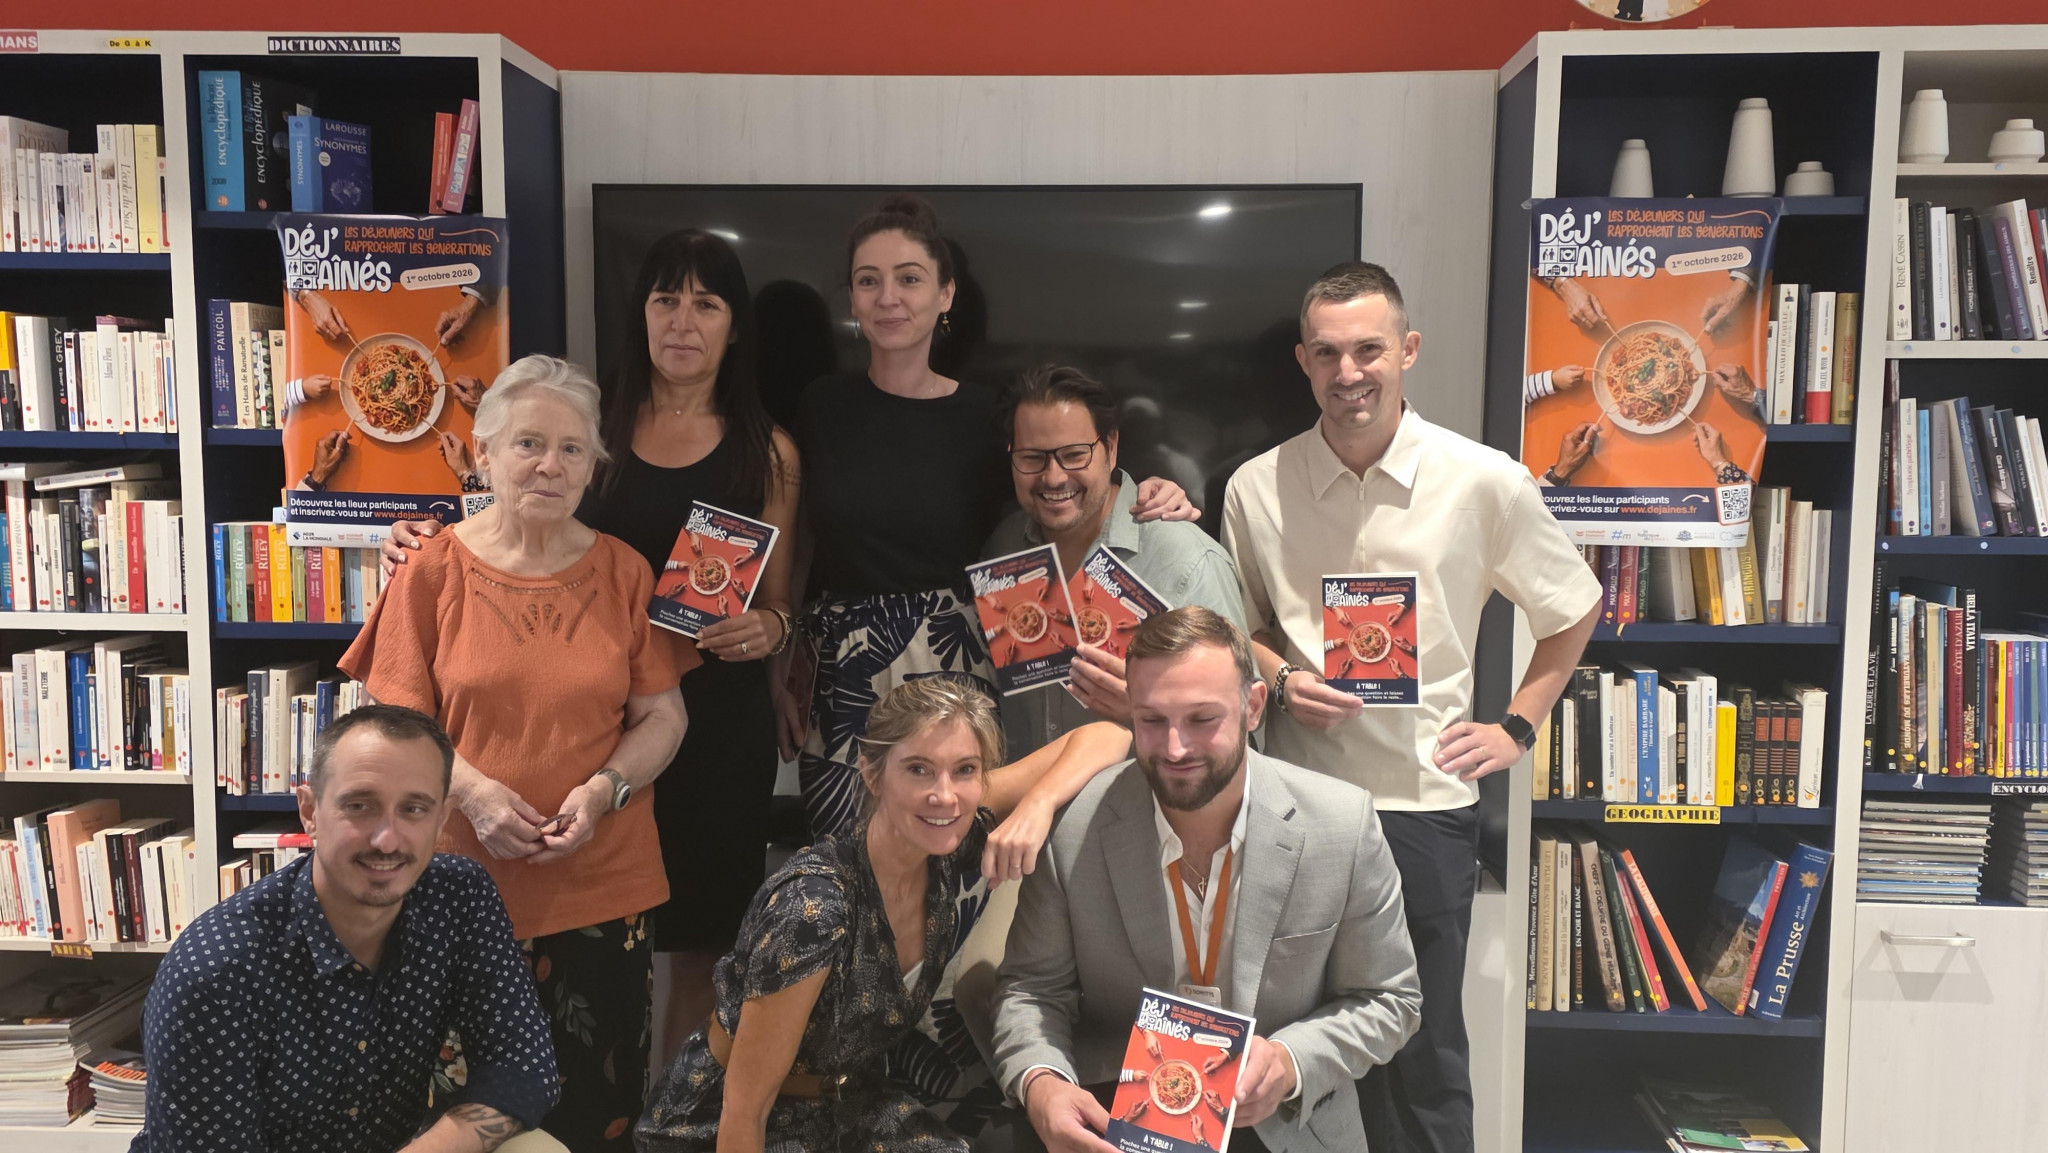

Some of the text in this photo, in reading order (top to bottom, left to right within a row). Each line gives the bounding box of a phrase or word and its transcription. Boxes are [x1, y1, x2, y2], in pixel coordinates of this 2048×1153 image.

[269, 38, 401, 52] DICTIONNAIRES
[325, 123, 368, 136] LAROUSSE
[314, 137, 367, 154] SYNONYMES
[1607, 224, 1674, 238] RAPPROCHENT
[344, 240, 405, 254] RAPPROCHENT
[1684, 256, 1720, 268] octobre
[1721, 252, 1744, 263] 2026
[1896, 234, 1906, 288] RENÉ CASSIN
[417, 271, 450, 283] octobre
[451, 268, 473, 278] 2026
[2026, 256, 2038, 285] Renaître
[215, 310, 226, 351] PANCOL
[54, 328, 64, 363] GREY
[239, 337, 248, 373] Ramatuelle
[242, 375, 248, 383] de
[1820, 356, 1828, 390] SOLEIL NOIR
[1906, 434, 1915, 496] Symphonie pathétique
[1996, 454, 2004, 469] Clara
[290, 498, 418, 511] Découvrez les lieux participants
[1576, 495, 1590, 504] les
[1592, 495, 1615, 504] lieux
[1616, 495, 1670, 506] participants
[290, 508, 444, 521] et inscrivez-vous sur www.dejaines.fr
[1604, 506, 1620, 514] sur
[1620, 505, 1698, 516] www.dejaines.fr
[1611, 530, 1632, 541] #m
[235, 539, 244, 569] RILEY
[258, 538, 268, 570] RILEY
[1624, 576, 1632, 592] GALLO
[1609, 592, 1617, 606] MAX
[1966, 594, 1976, 651] BELLA ITALIA
[1954, 612, 1963, 674] CÔTE D'AZUR
[1868, 652, 1876, 664] VIE
[1868, 666, 1875, 676] LA
[40, 671, 48, 700] MALETERRE
[1867, 677, 1874, 688] ET
[1903, 655, 1911, 705] NATURELLES
[165, 686, 173, 707] MUSSO
[1866, 689, 1874, 714] TERRE
[1865, 715, 1873, 725] LA
[1903, 707, 1910, 718] DU
[1993, 785, 2048, 794] ENCYCLO
[1606, 808, 1719, 821] GEOGRAPHIE
[1628, 862, 1636, 872] LA
[1800, 892, 1812, 920] Architecture
[1600, 926, 1608, 936] DU
[1575, 937, 1582, 947] EN
[1602, 937, 1612, 959] GENIE
[54, 944, 92, 956] ARTS
[1776, 921, 1805, 980] Prusse
[1529, 937, 1537, 981] Merveilleuses
[1768, 984, 1788, 1005] La
[1120, 1138, 1140, 1149] Piochez
[1150, 1136, 1169, 1149] TABLE
